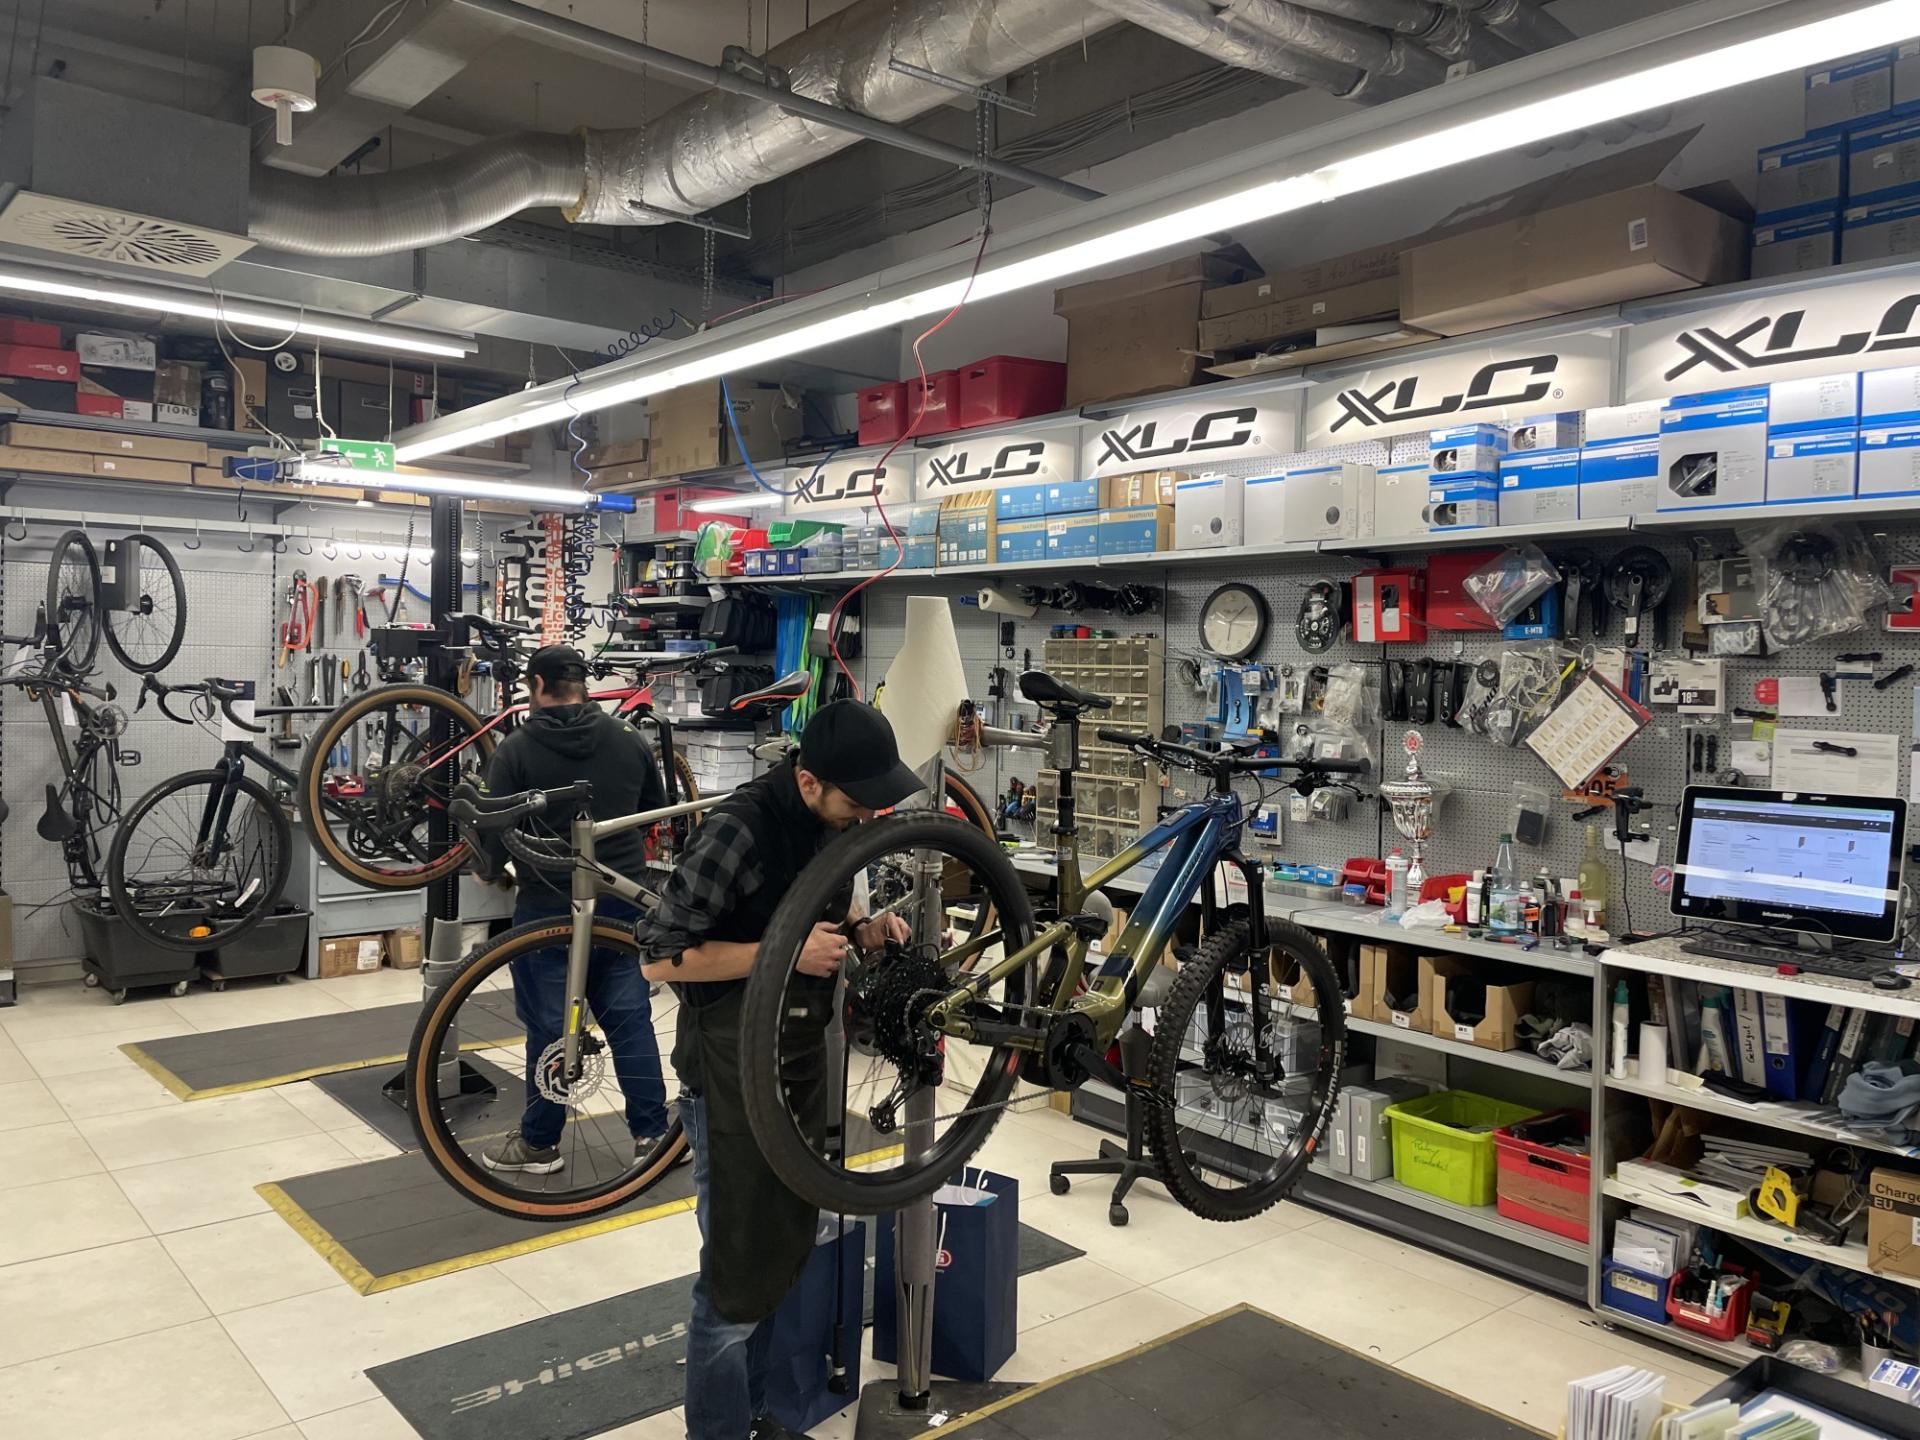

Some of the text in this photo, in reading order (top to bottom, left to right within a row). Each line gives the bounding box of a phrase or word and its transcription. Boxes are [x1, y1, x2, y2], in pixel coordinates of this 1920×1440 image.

[1330, 354, 1559, 433] XLC
[1097, 407, 1258, 466] XLC
[926, 442, 1045, 489] XLC
[793, 467, 887, 505] XLC
[1525, 626, 1543, 635] E-MTB
[1681, 692, 1692, 704] 18
[1874, 1197, 1894, 1210] EU
